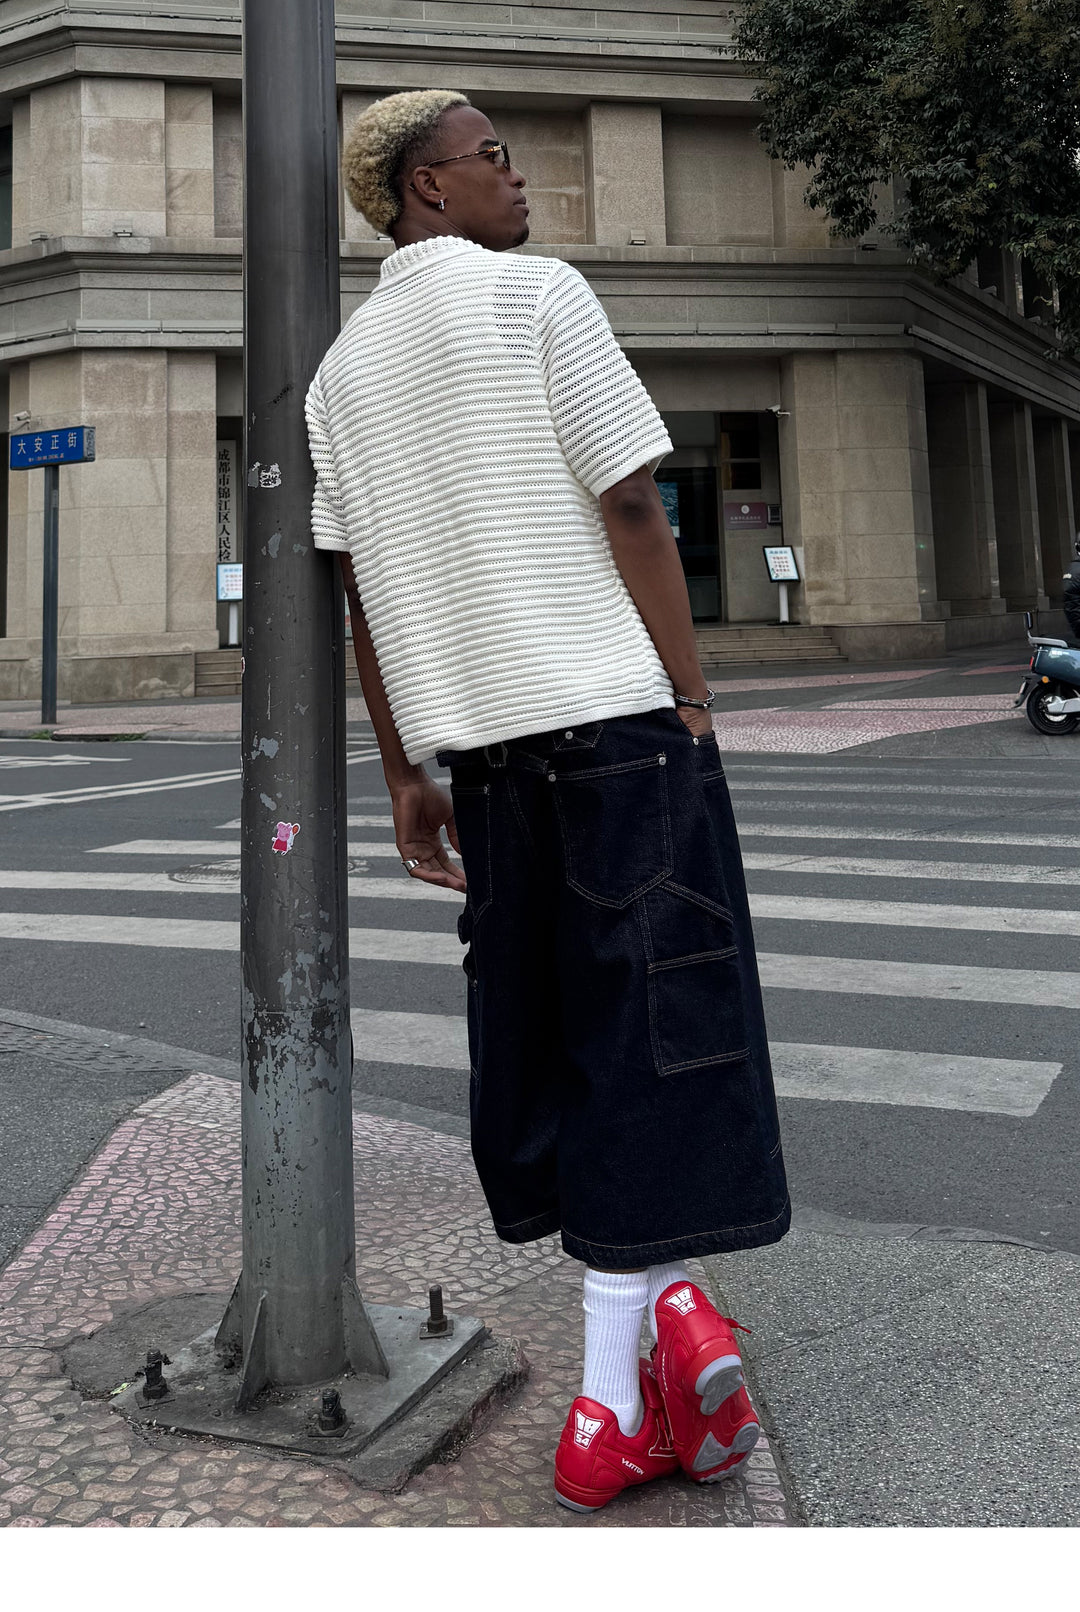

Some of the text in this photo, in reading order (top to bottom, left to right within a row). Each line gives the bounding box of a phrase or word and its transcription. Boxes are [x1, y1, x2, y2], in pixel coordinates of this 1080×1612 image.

[17, 431, 77, 455] 大安正街
[218, 448, 231, 562] 成都市锦江区人民检
[667, 1288, 690, 1306] 18
[680, 1301, 695, 1313] 54
[576, 1412, 602, 1436] 18
[575, 1433, 591, 1447] 54
